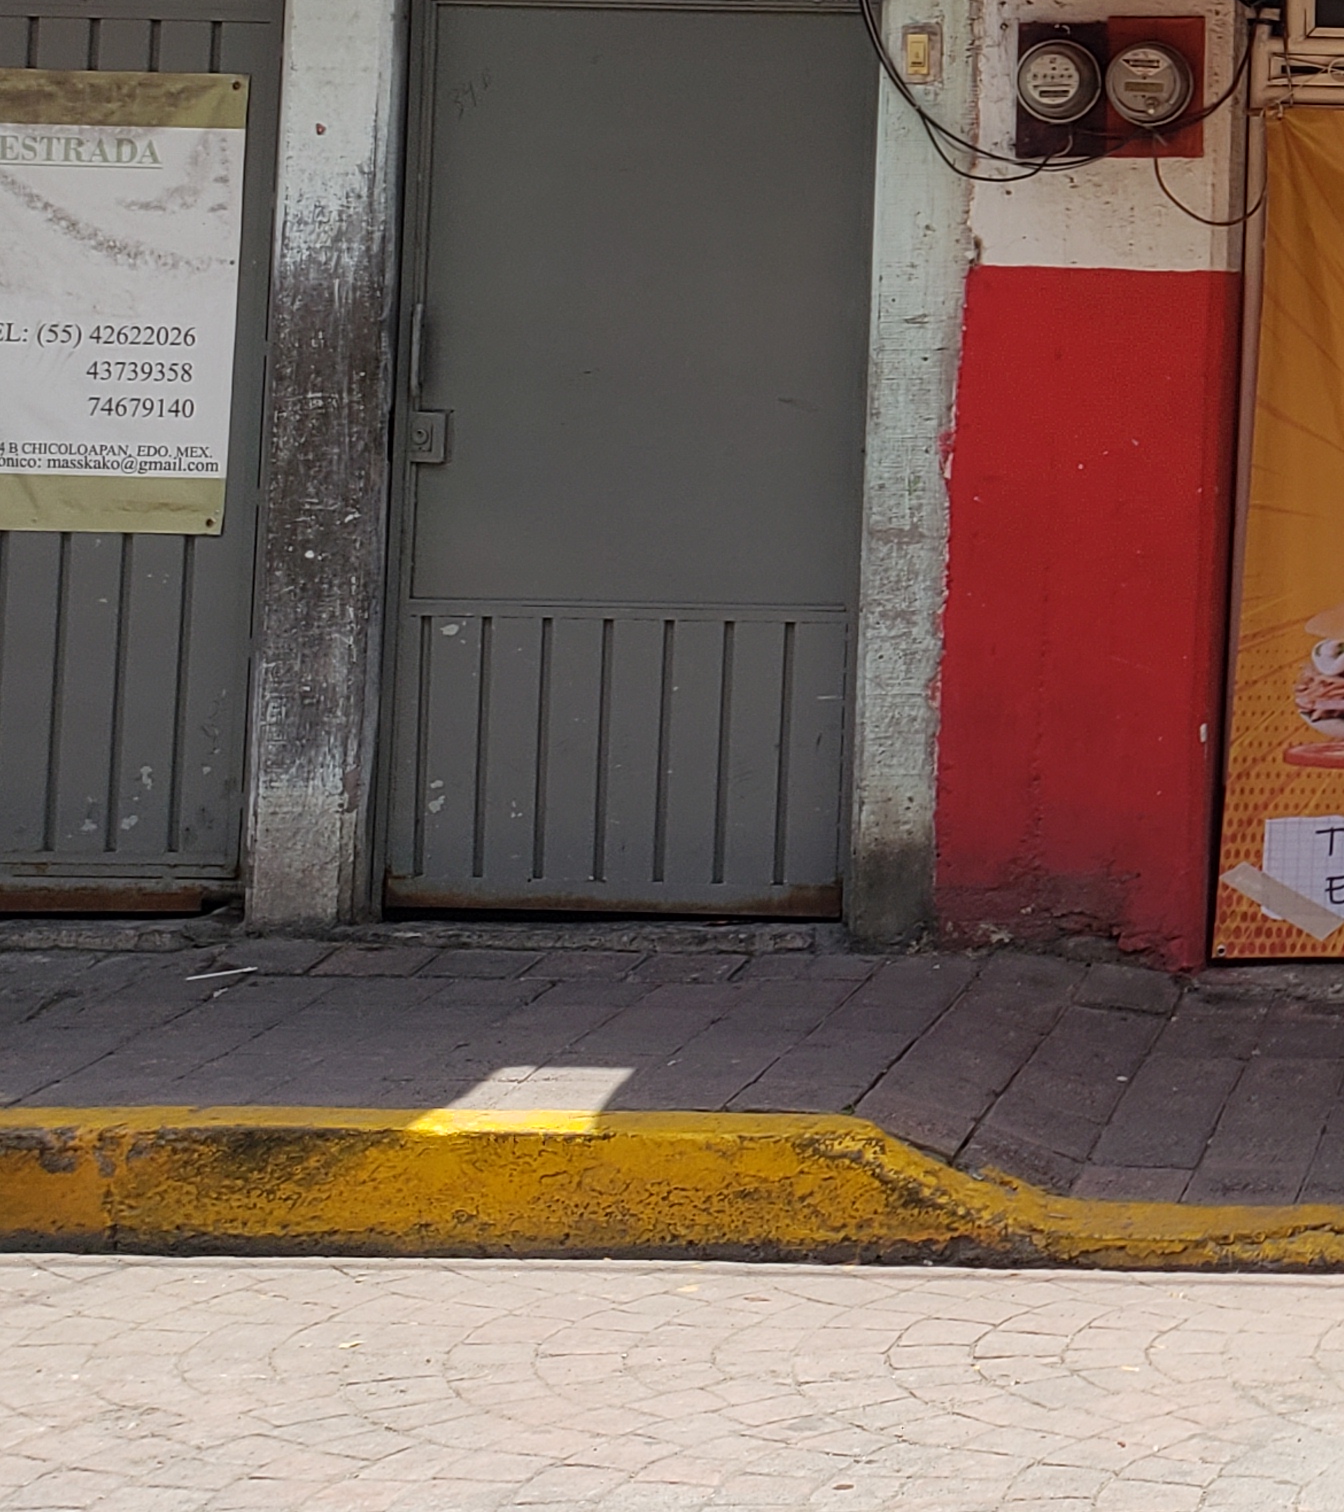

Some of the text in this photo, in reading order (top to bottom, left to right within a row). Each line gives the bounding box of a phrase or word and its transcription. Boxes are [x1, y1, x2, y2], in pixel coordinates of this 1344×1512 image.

[0, 135, 162, 164] ESTRADA
[37, 324, 82, 349] (55)
[89, 325, 196, 346] 42622026
[86, 361, 194, 382] 43739358
[87, 397, 195, 418] 74679140
[21, 443, 133, 458] CHICOLOAPAN,
[137, 445, 173, 458] EDO.
[176, 445, 213, 458] MEX.
[47, 455, 219, 474] masskako@gmail.com
